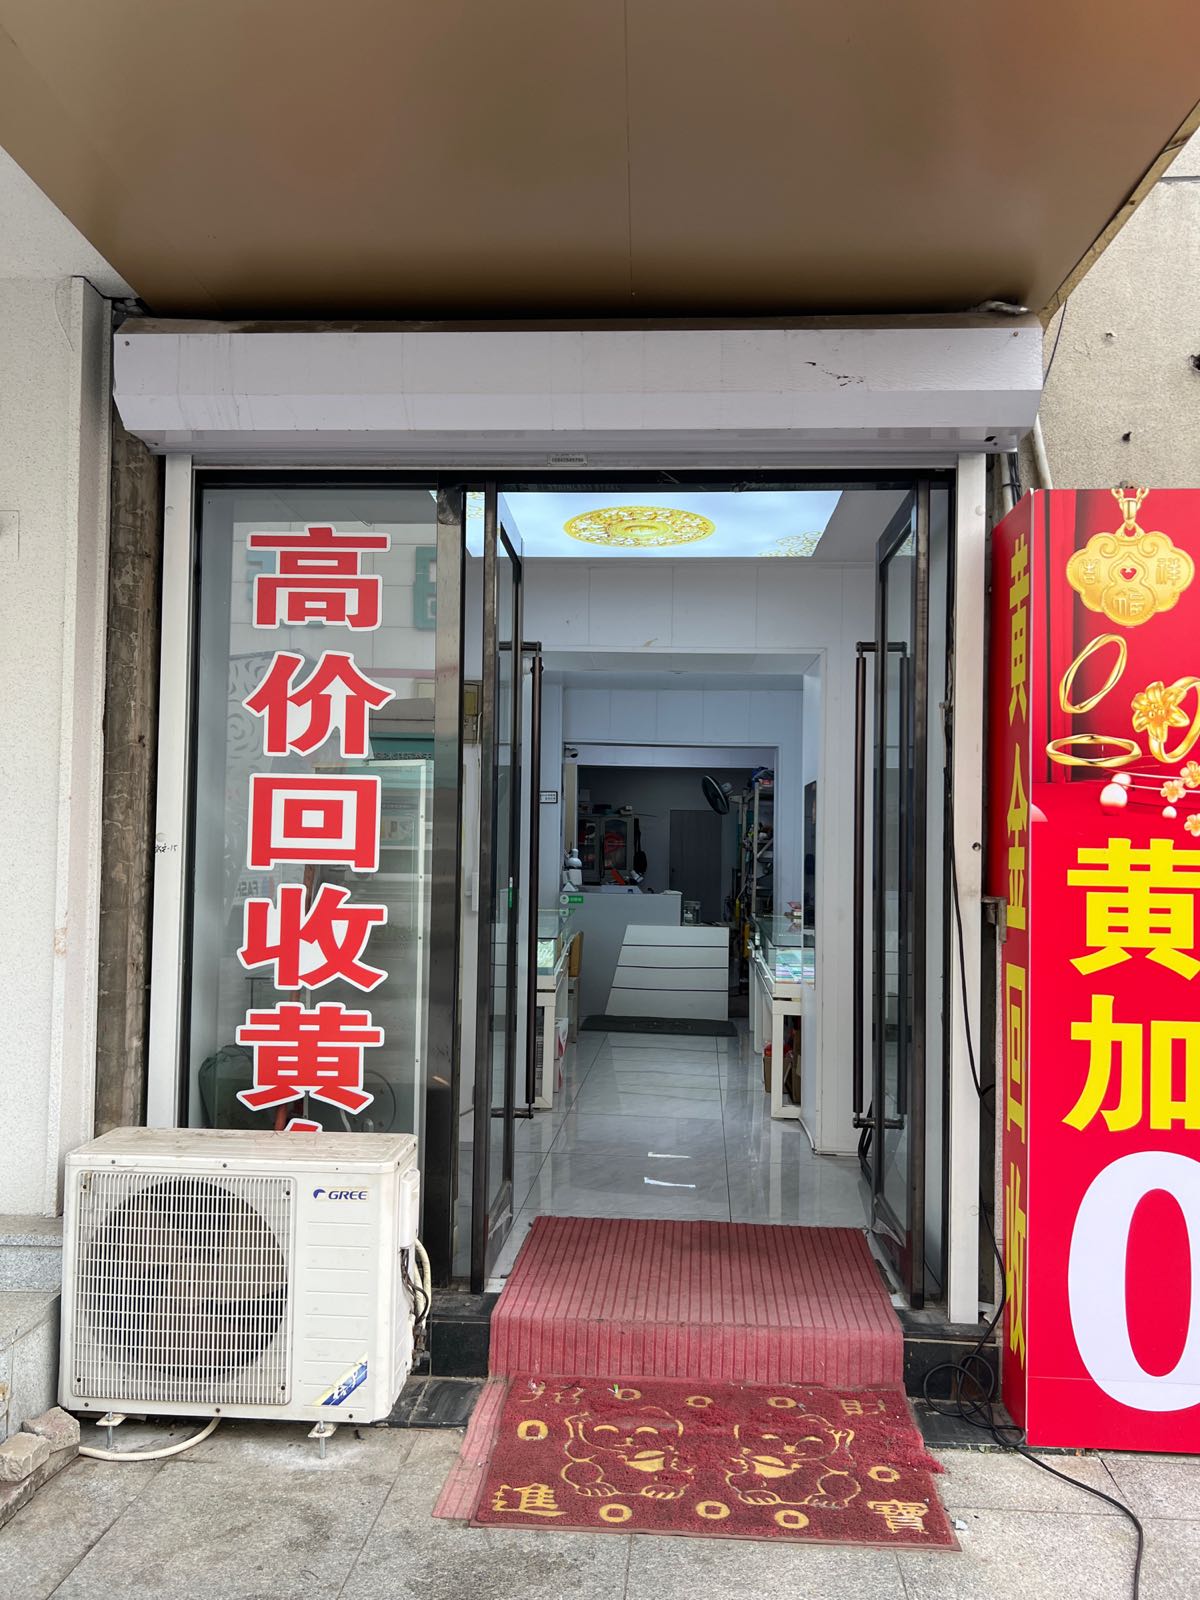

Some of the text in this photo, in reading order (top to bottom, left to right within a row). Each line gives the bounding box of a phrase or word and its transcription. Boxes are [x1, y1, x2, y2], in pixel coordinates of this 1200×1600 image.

[236, 524, 396, 1132] 高价回收黄
[1005, 532, 1029, 1368] 黄金回收
[328, 1190, 367, 1200] GREE
